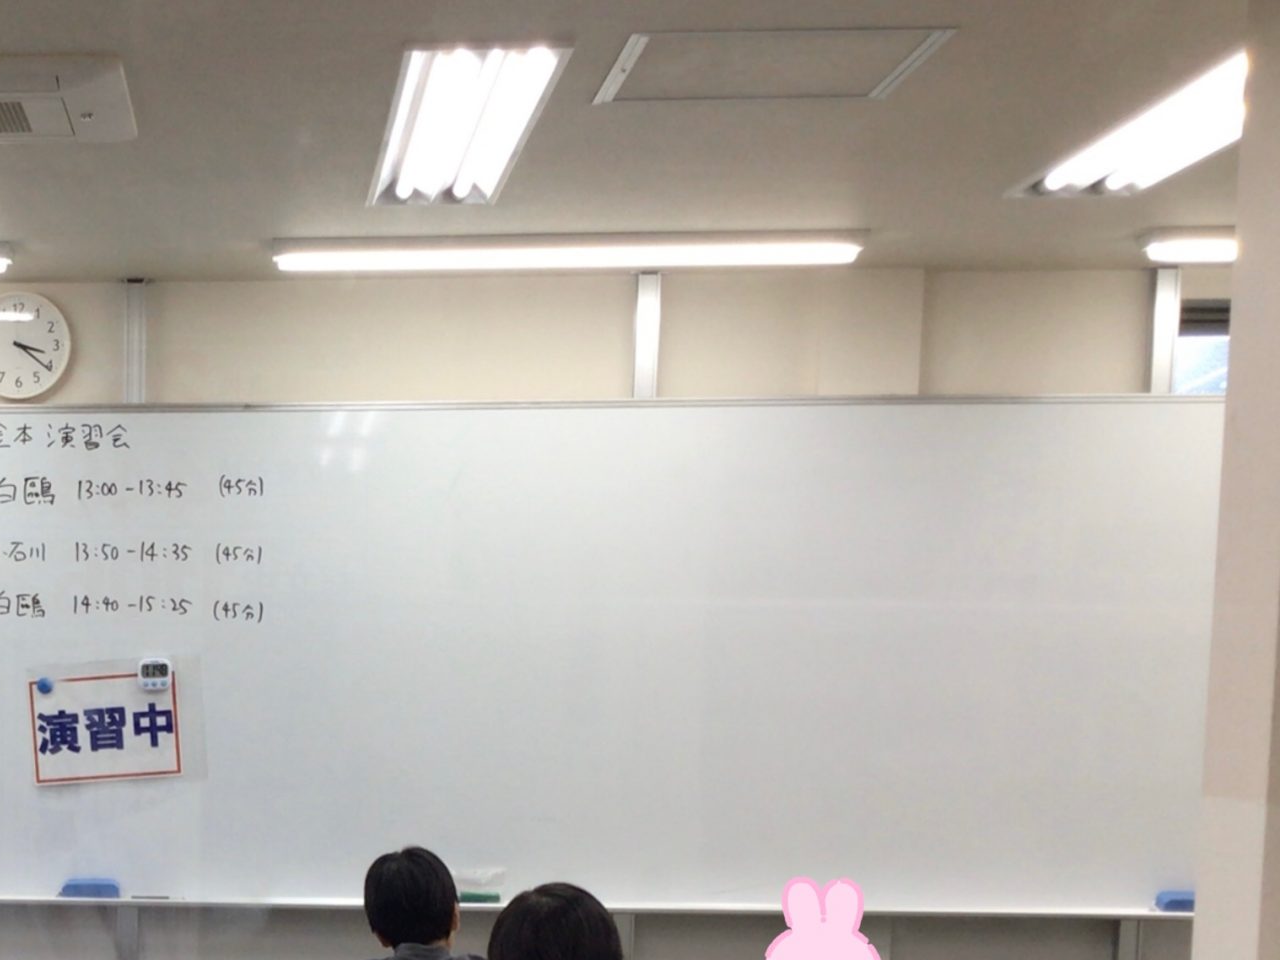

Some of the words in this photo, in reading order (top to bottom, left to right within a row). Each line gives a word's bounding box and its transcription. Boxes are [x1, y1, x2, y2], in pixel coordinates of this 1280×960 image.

[47, 321, 55, 333] 2
[52, 339, 60, 351] 3
[14, 376, 23, 388] 6
[33, 371, 41, 384] 5
[218, 475, 264, 498] (45分)
[216, 543, 262, 565] (45分)
[213, 599, 264, 623] (45分)
[37, 702, 174, 755] 演習中
